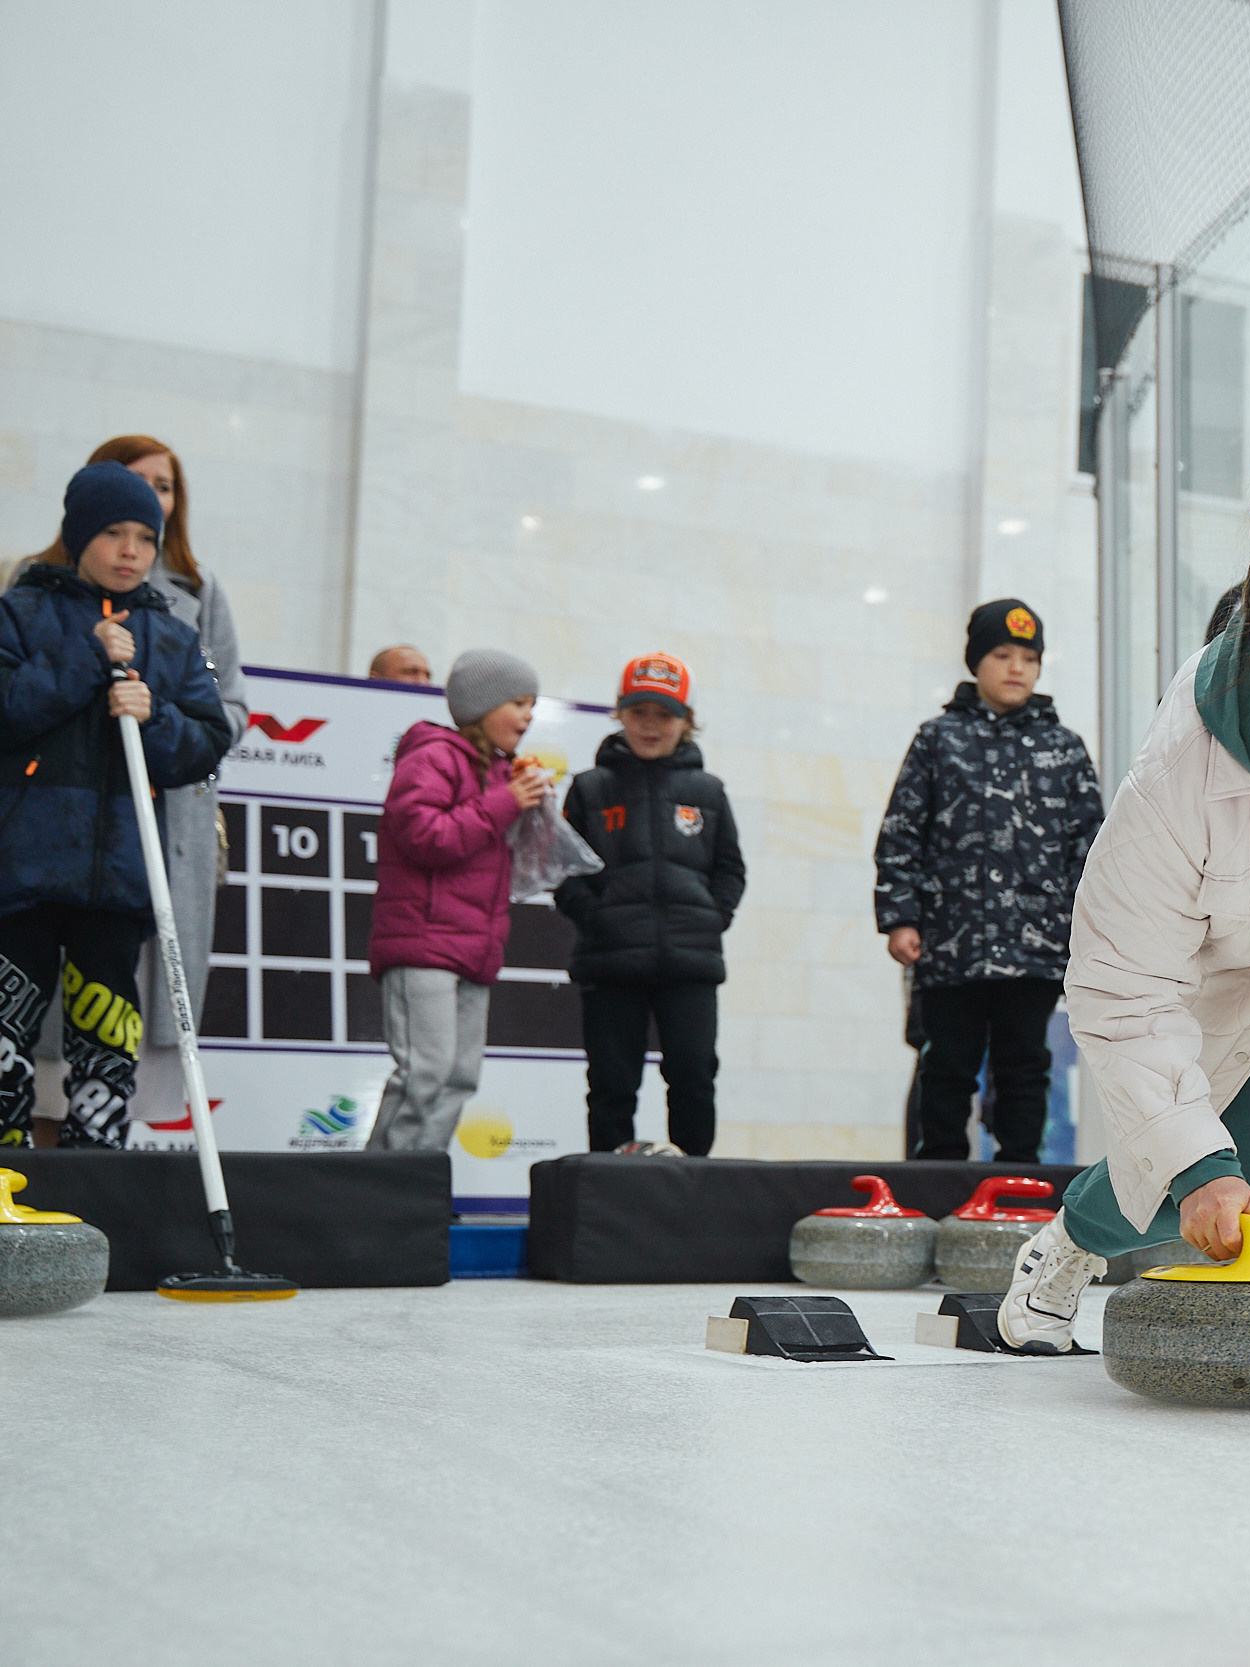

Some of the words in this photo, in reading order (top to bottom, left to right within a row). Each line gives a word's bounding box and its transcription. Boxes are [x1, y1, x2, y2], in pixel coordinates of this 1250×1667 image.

[226, 746, 275, 763] ОВАЯ
[271, 824, 319, 860] 10
[359, 831, 379, 864] 1
